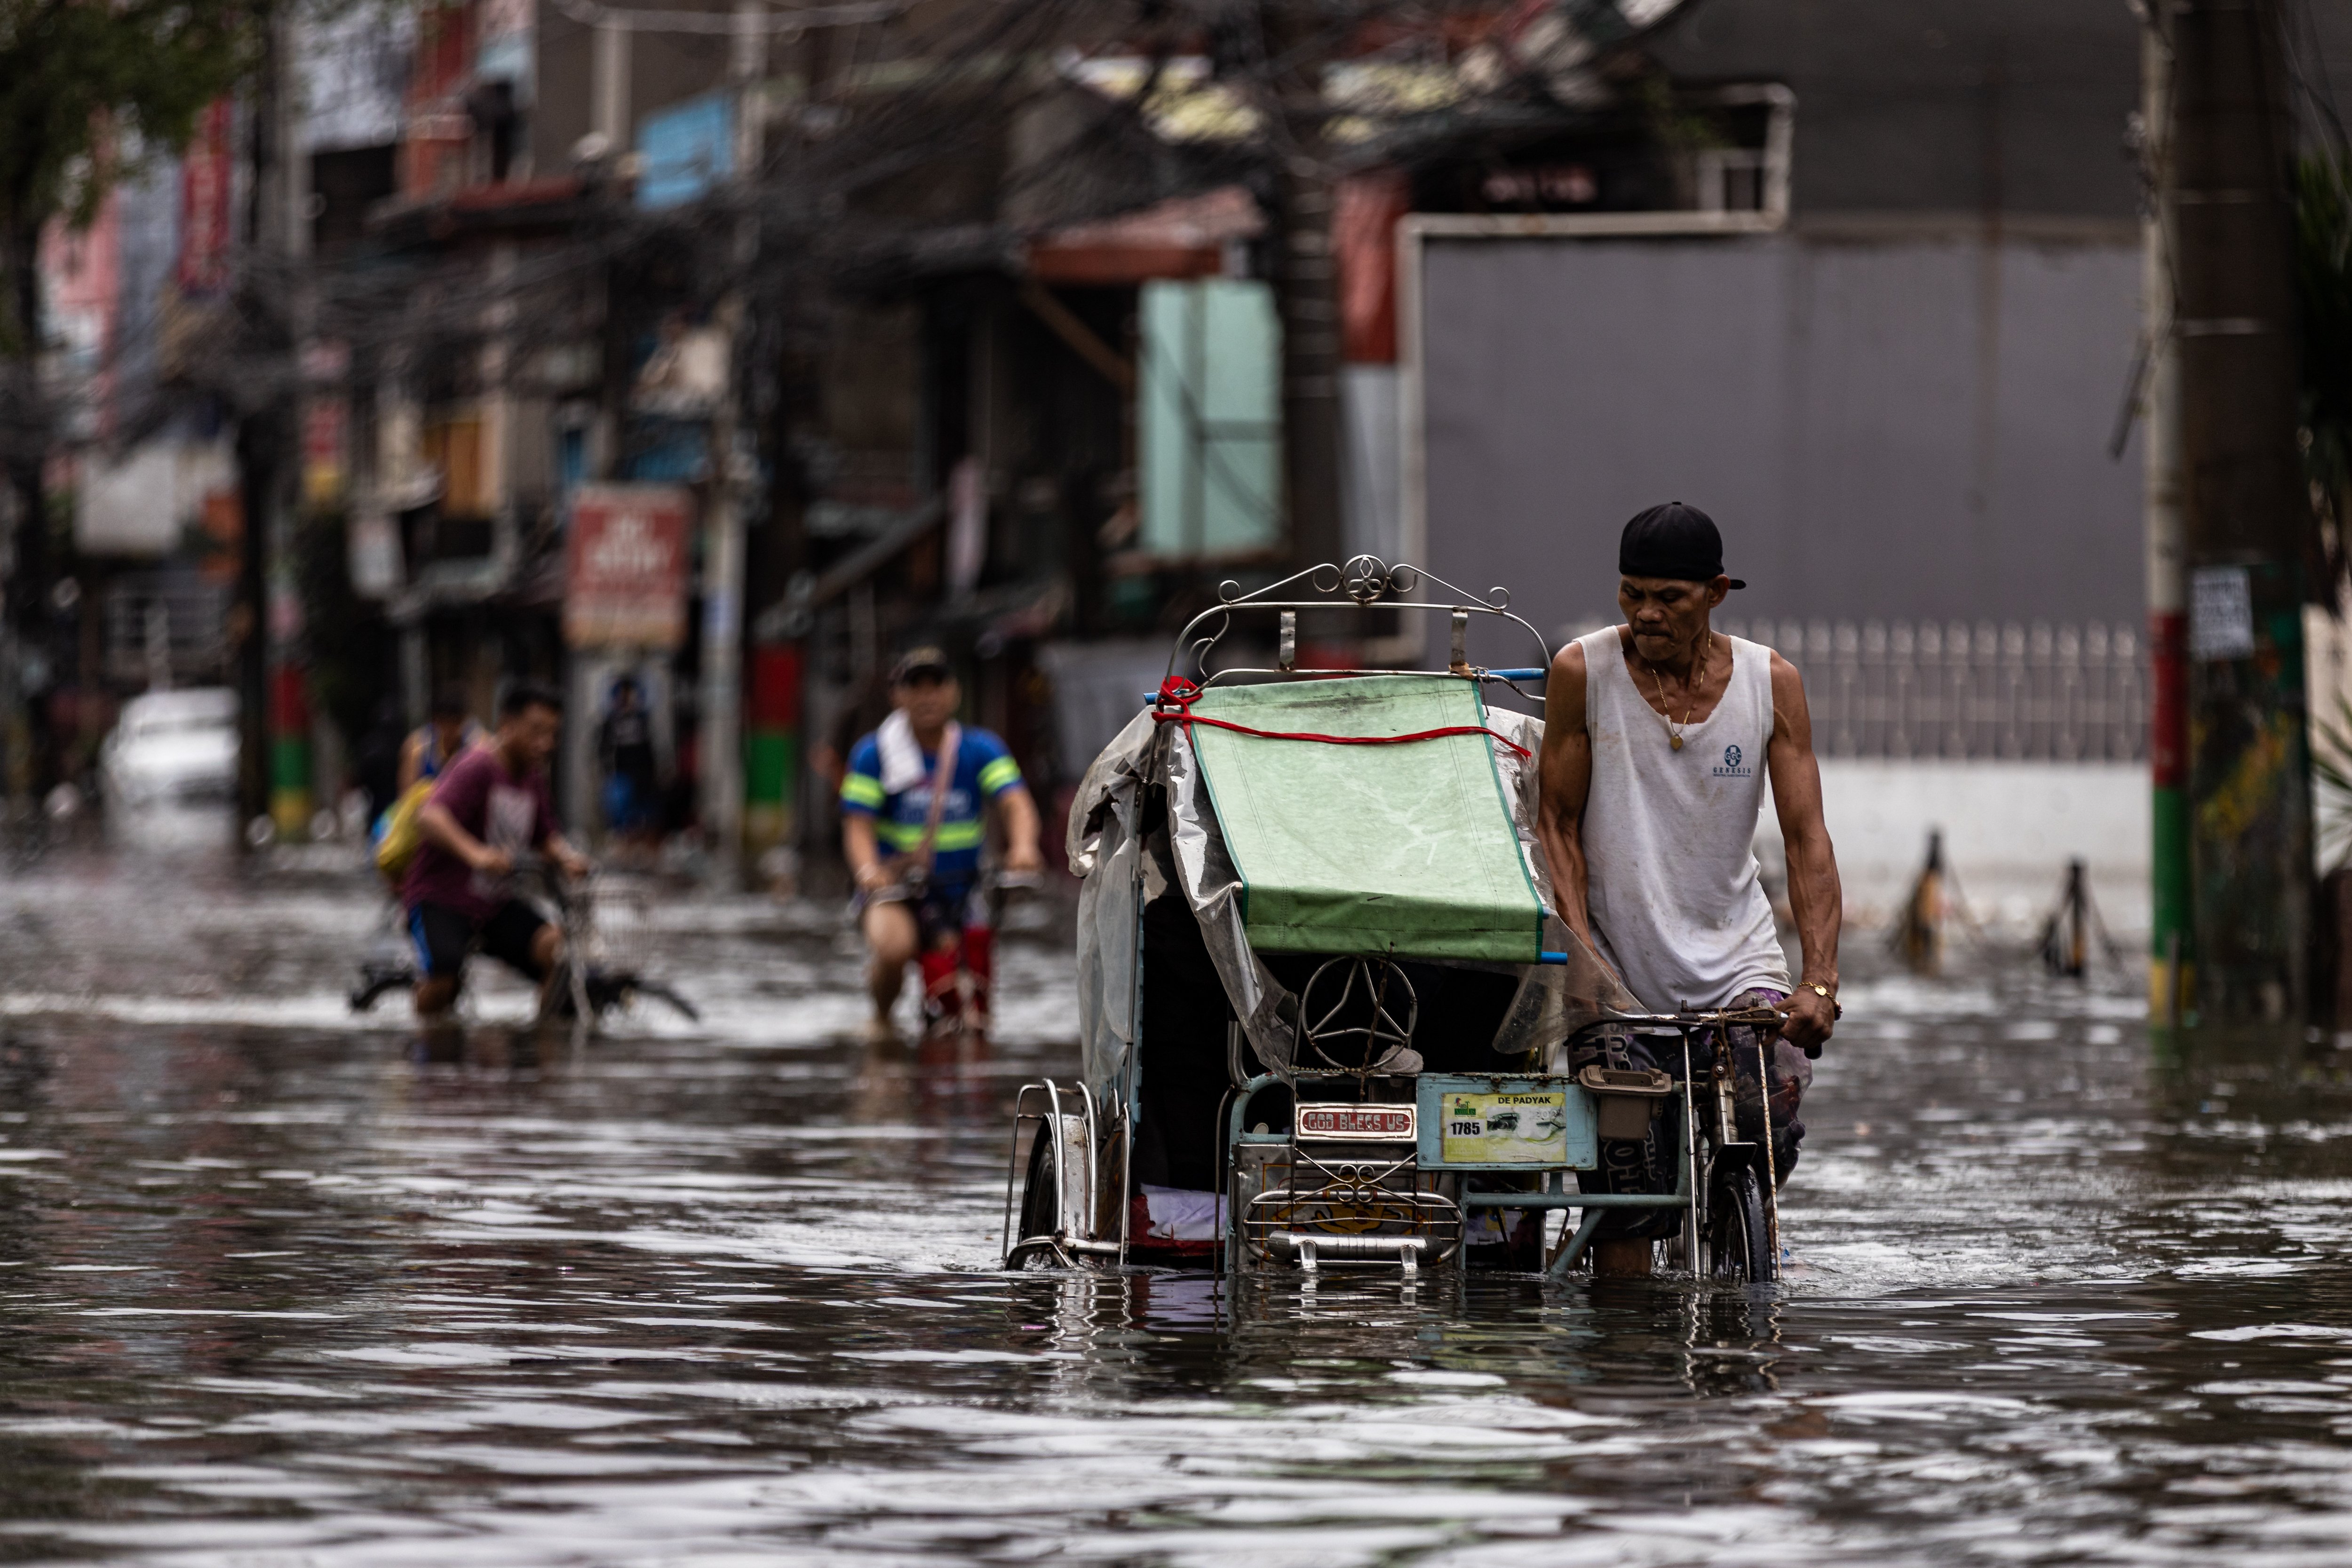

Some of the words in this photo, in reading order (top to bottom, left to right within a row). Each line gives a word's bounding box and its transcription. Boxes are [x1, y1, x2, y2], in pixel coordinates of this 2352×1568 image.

[1308, 1114, 1334, 1129] GOD
[1340, 1114, 1382, 1130] BLESS
[1387, 1115, 1404, 1131] US
[1451, 1122, 1480, 1135] 1785
